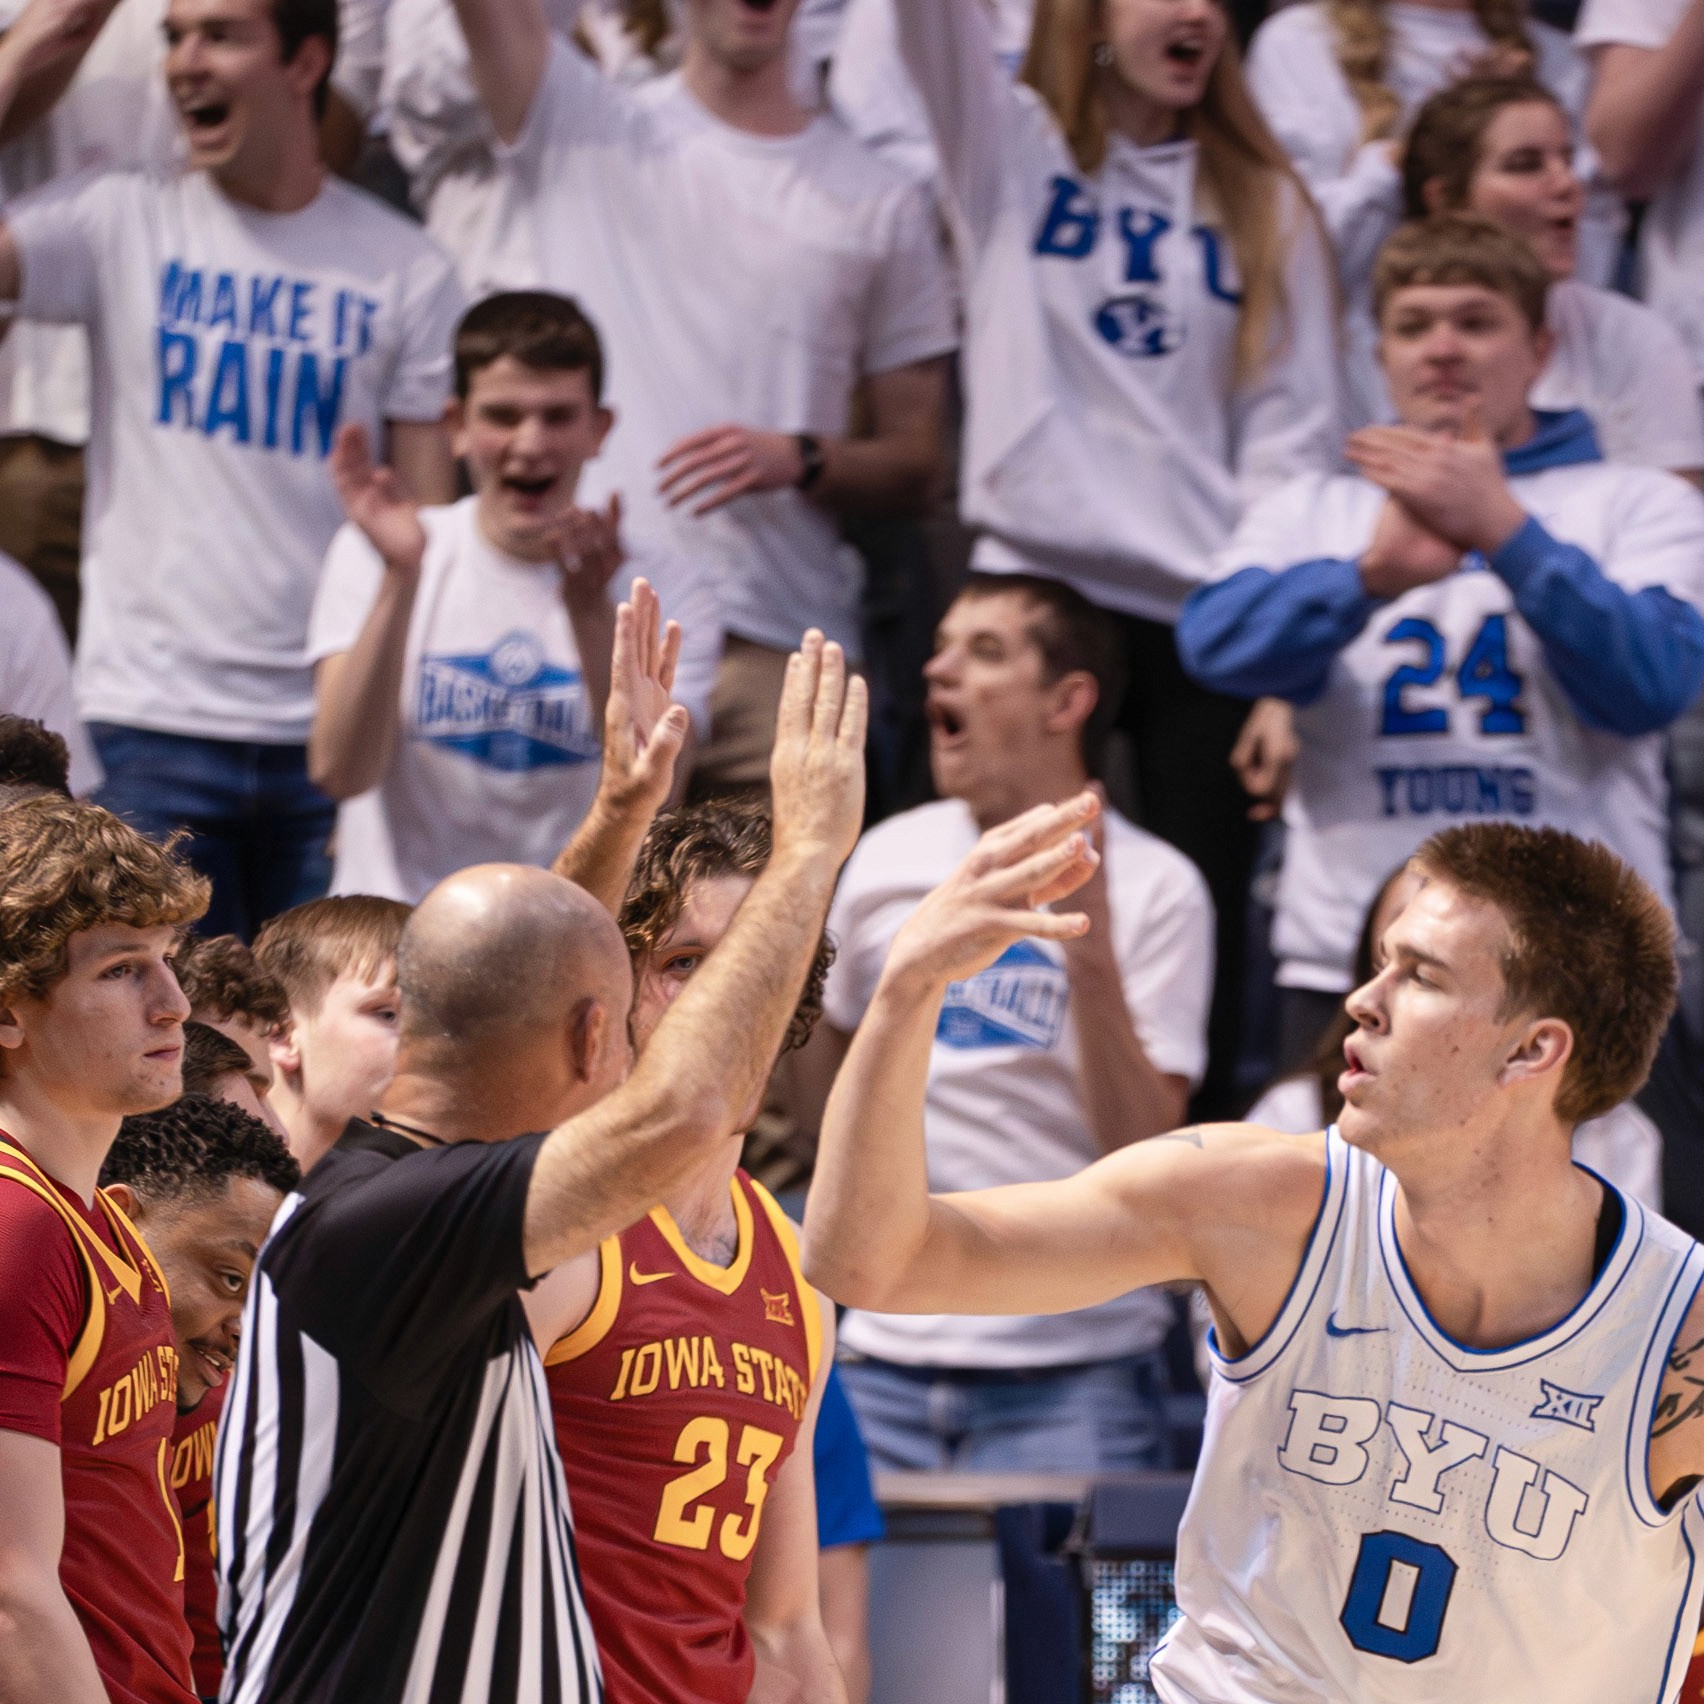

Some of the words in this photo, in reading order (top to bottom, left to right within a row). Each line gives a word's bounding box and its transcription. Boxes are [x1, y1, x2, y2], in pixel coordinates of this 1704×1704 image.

[158, 258, 314, 342] MAKE
[332, 289, 380, 357] IT
[157, 325, 345, 459] RAIN
[1381, 615, 1527, 736] 24
[1376, 765, 1537, 817] YOUNG
[92, 1350, 159, 1446] IOWA
[609, 1335, 725, 1401] IOWA
[653, 1415, 785, 1562] 23
[1277, 1387, 1589, 1562] BYU
[1339, 1529, 1460, 1665] 0
